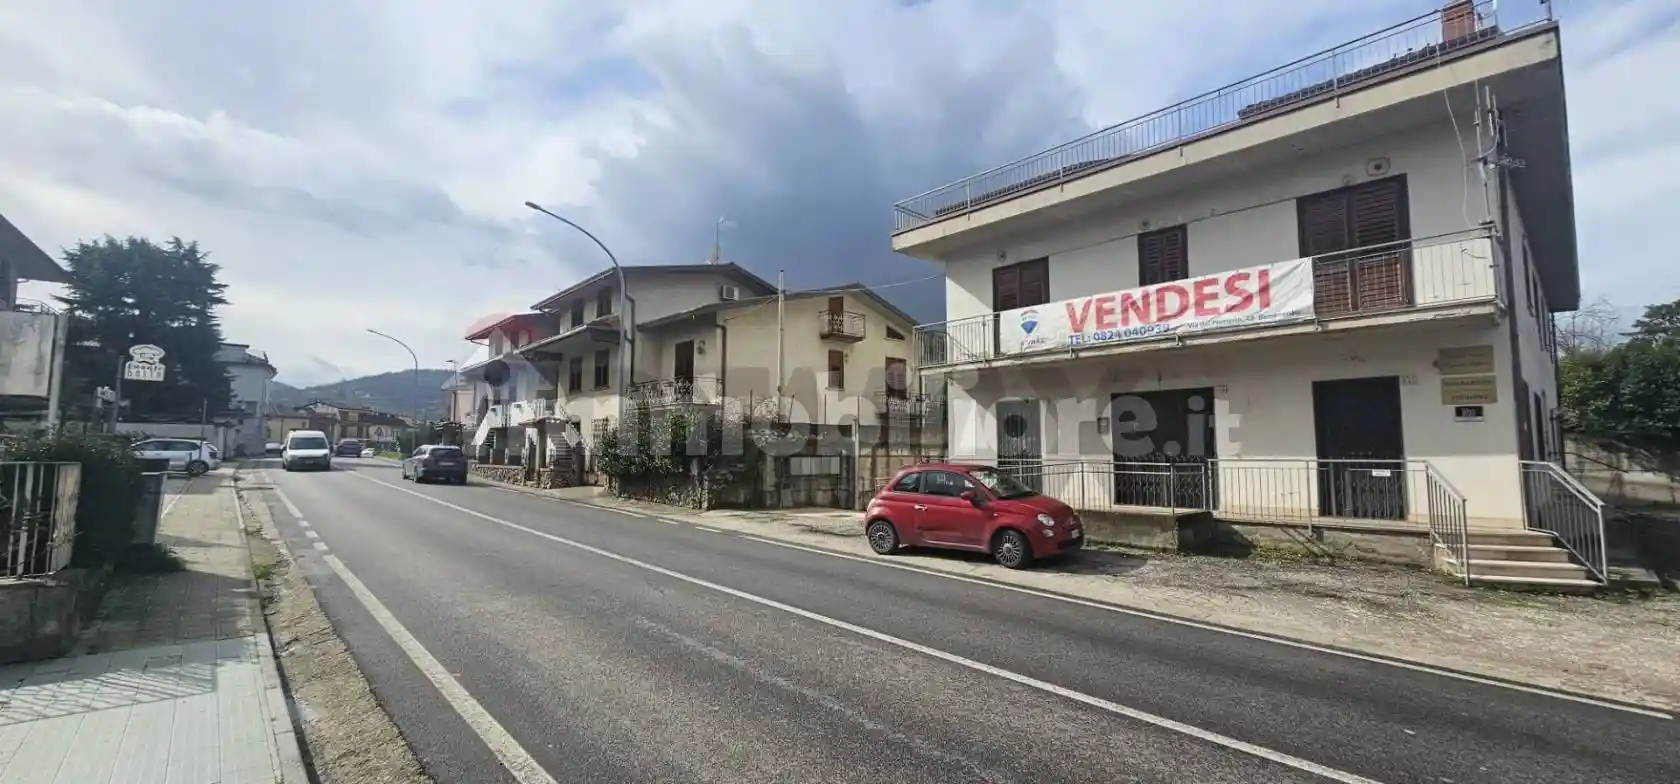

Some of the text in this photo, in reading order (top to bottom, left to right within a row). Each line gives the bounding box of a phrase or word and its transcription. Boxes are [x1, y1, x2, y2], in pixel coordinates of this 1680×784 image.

[1065, 269, 1272, 333] VENDESI
[1068, 333, 1091, 345] TEL:
[1093, 330, 1122, 341] 0824
